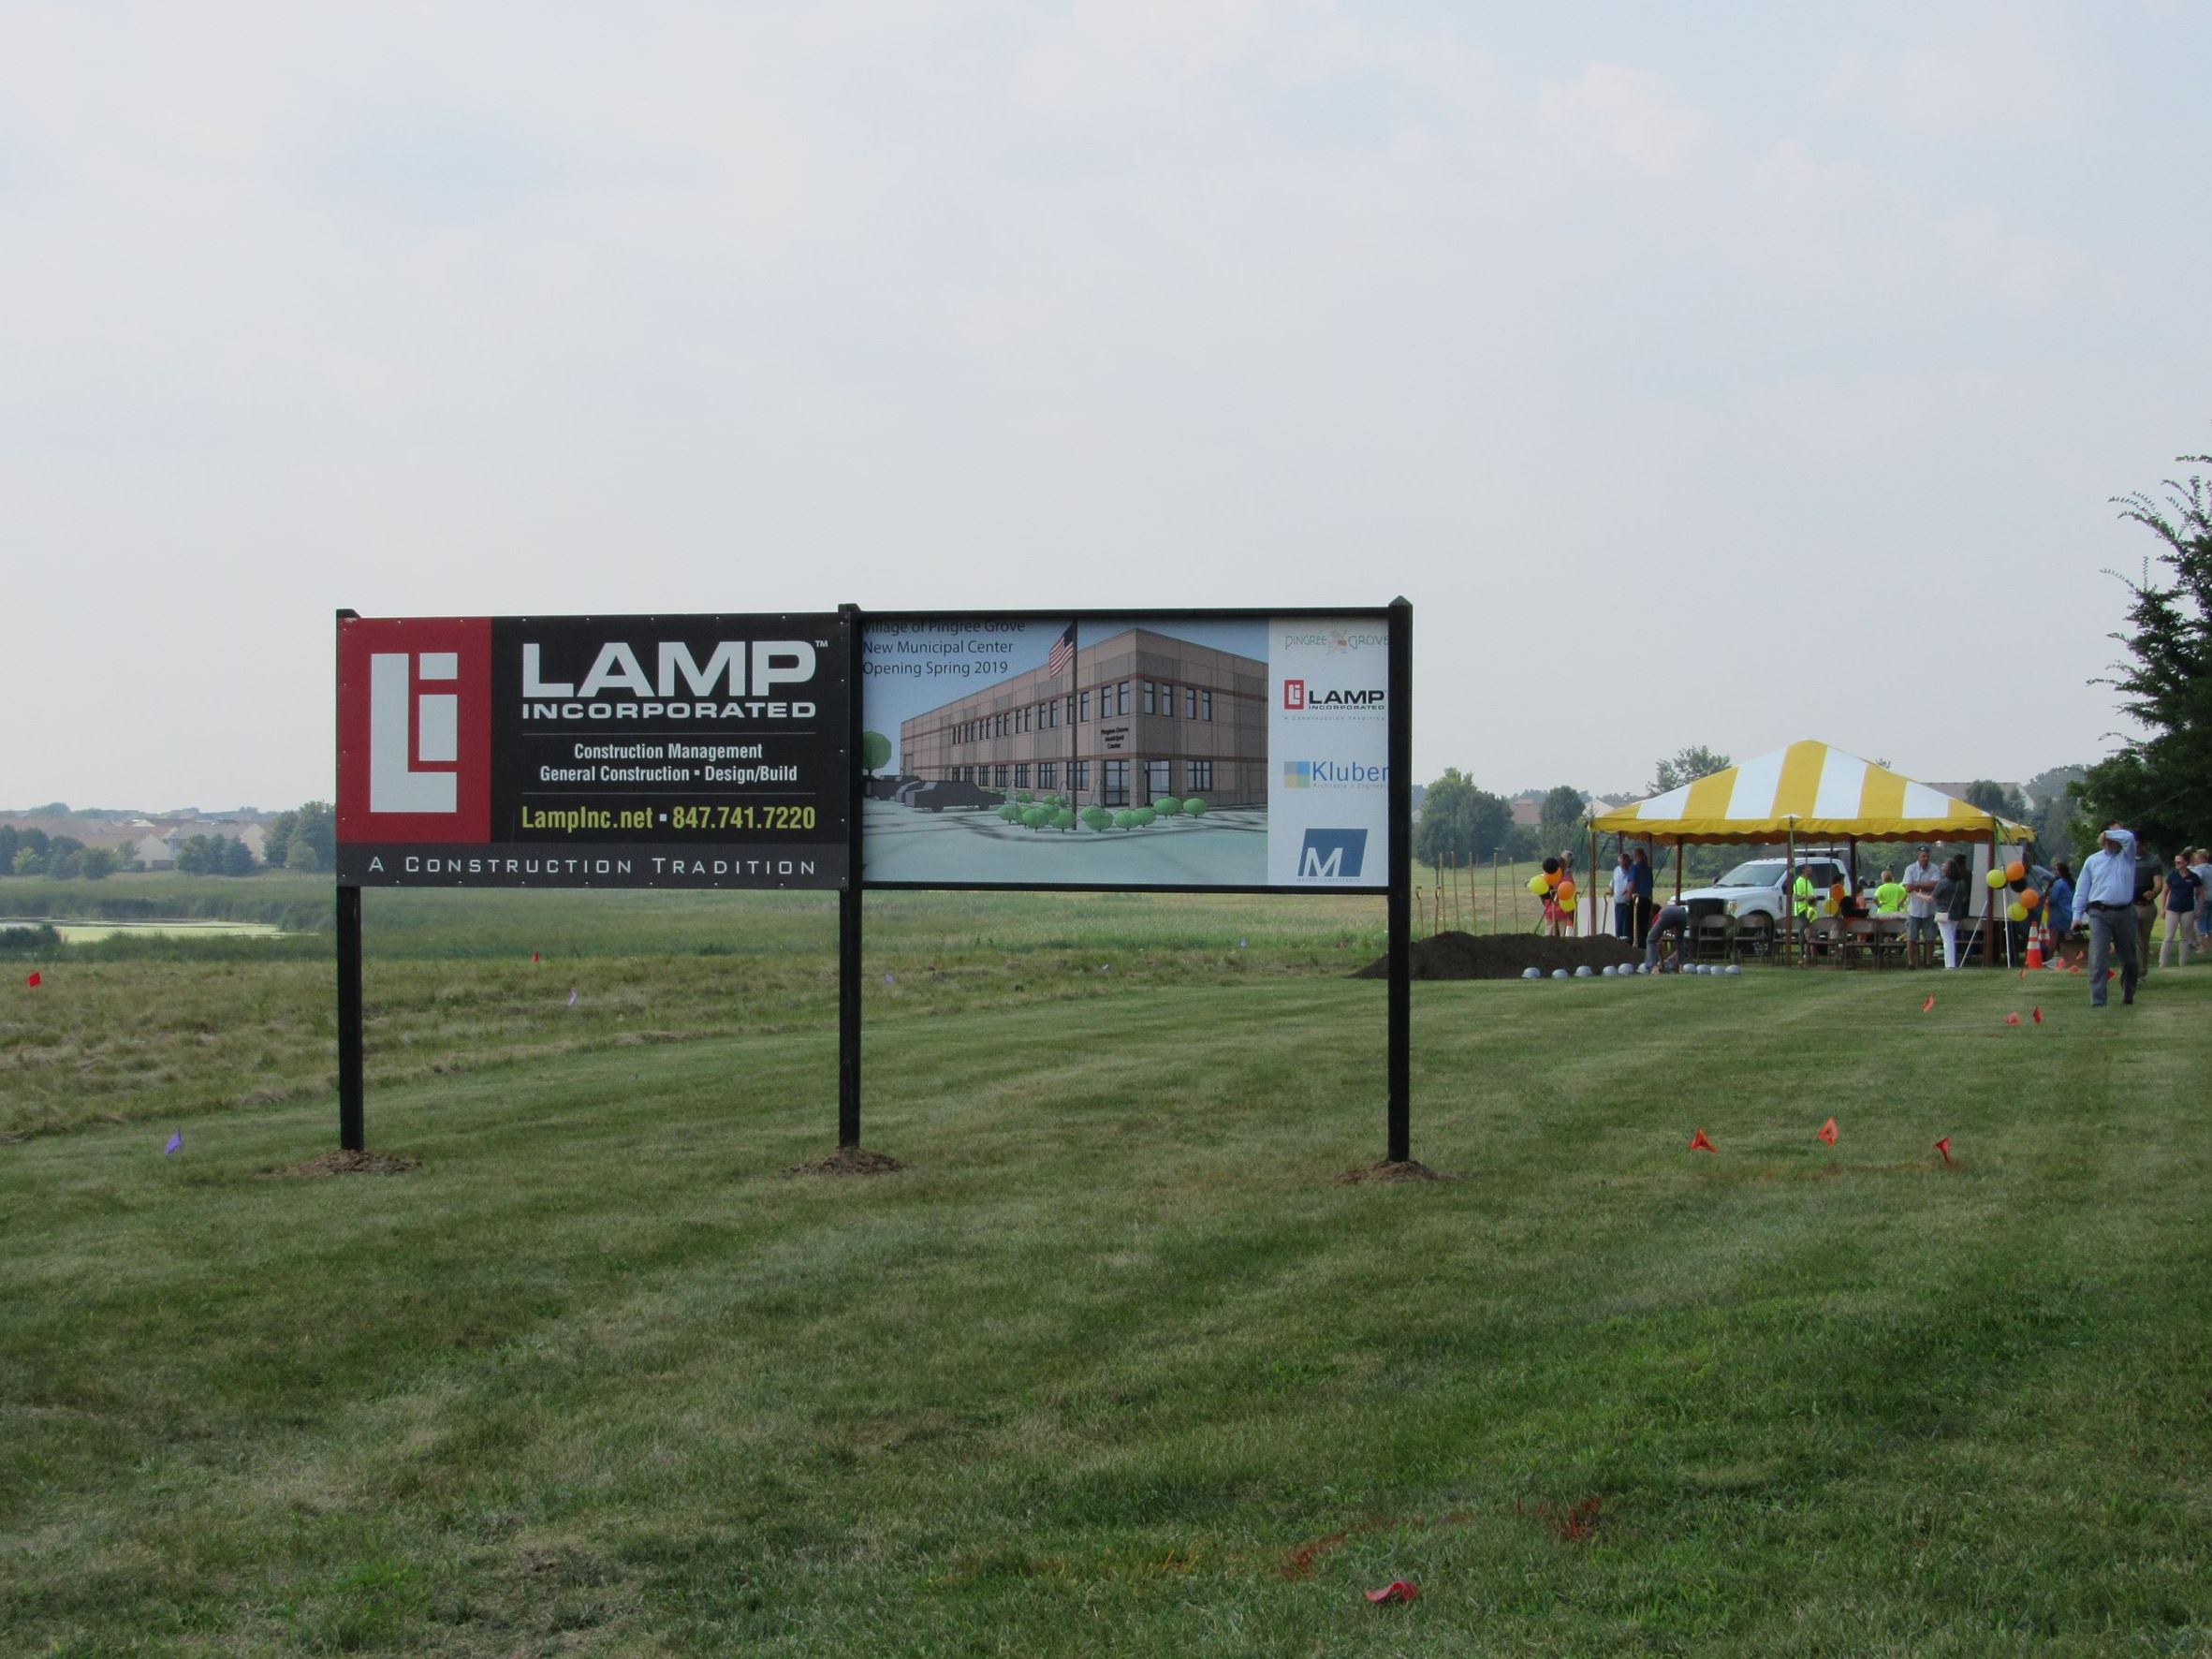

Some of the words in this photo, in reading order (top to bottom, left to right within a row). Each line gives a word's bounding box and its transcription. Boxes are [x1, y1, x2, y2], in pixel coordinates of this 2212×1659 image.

[864, 620, 908, 636] Village
[929, 620, 981, 636] Pingree
[985, 620, 1026, 633] Grove
[863, 640, 893, 653] New
[898, 640, 964, 656] Municipal
[968, 640, 1013, 653] Center
[522, 640, 816, 697] LAMP
[863, 661, 922, 677] Opening
[926, 661, 970, 677] Spring
[974, 661, 1008, 674] 2019
[1308, 690, 1384, 704] LAMP
[521, 702, 817, 719] INCORPORATED
[574, 743, 664, 758] Construction
[668, 742, 763, 761] Management
[540, 766, 596, 781] General
[600, 765, 690, 781] Construction
[704, 765, 798, 784] Design/Build
[1312, 761, 1389, 781] Kluber
[521, 806, 653, 832] LampInc.net
[672, 806, 816, 830] 847.741.7220
[368, 856, 385, 873] A
